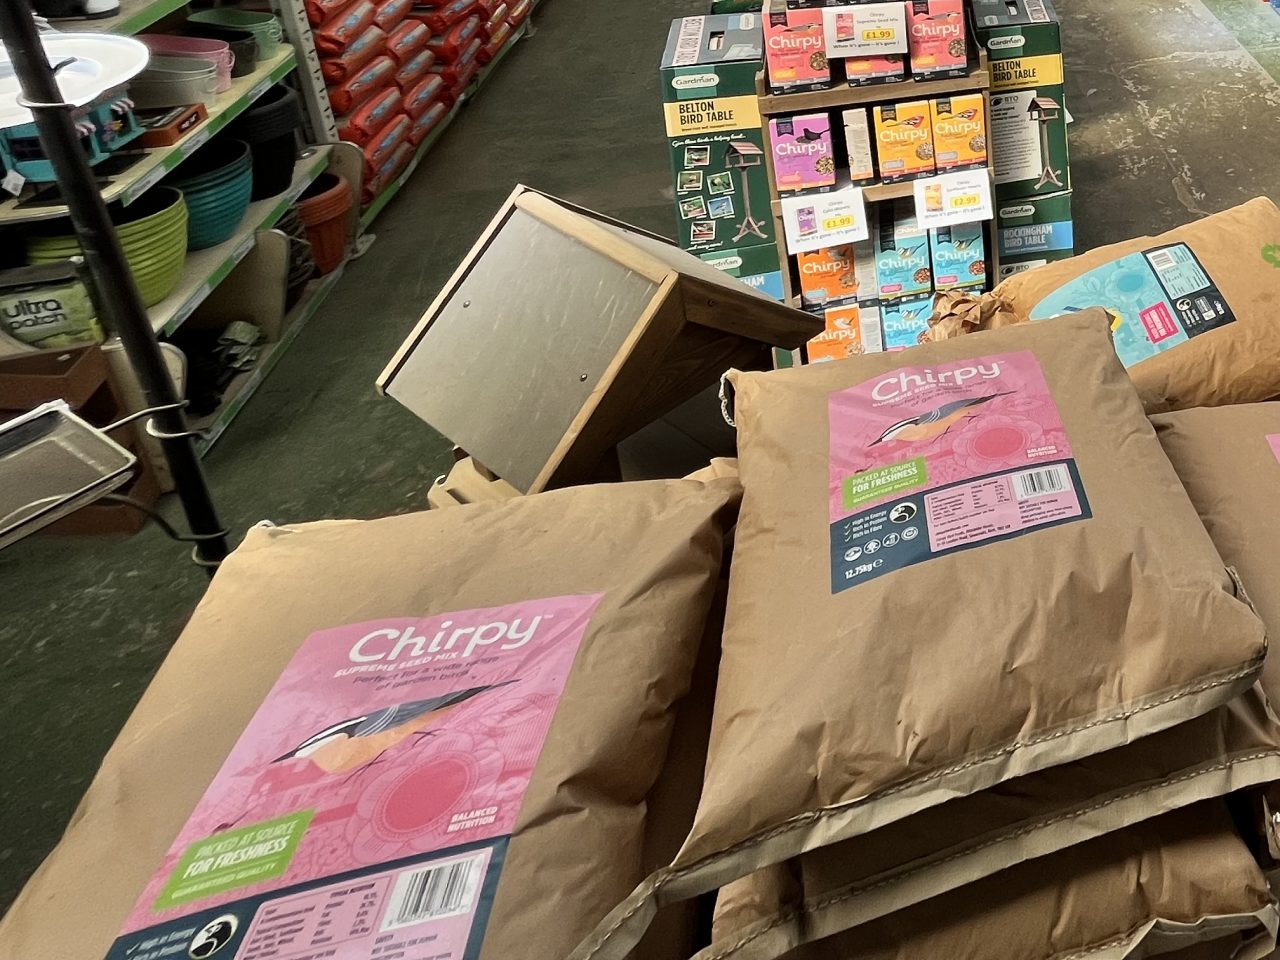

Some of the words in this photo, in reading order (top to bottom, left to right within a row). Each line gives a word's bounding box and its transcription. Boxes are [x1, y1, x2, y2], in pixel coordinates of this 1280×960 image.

[866, 31, 891, 39] £1.99
[911, 21, 961, 39] Chirpy
[768, 33, 822, 53] Chirpy
[990, 37, 1021, 46] Gardman
[992, 60, 1021, 72] BELTON
[675, 76, 715, 86] Gardman
[993, 72, 1012, 82] BIRD
[1014, 68, 1036, 79] TABLE
[679, 101, 714, 114] BELTON
[680, 114, 703, 125] BIRD
[706, 110, 734, 122] TABLE
[934, 120, 981, 134] Chirpy
[879, 128, 929, 143] Chirpy
[775, 140, 828, 157] Chirpy
[954, 197, 977, 206] £2.99
[1001, 206, 1032, 217] Gardman
[826, 217, 851, 228] £1.99
[1003, 225, 1053, 239] ROCKINGHAM
[1004, 237, 1021, 248] BIRD
[1023, 234, 1046, 245] TABLE
[879, 255, 926, 271] Chirpy
[934, 248, 981, 263] Chirpy
[801, 259, 850, 274] Chirpy
[2, 297, 63, 319] ultra
[871, 361, 1000, 401] Chirpy
[872, 391, 912, 407] SUPREME
[852, 471, 879, 486] PACKED
[880, 469, 888, 477] AT
[890, 461, 916, 474] SOURCE
[852, 482, 870, 495] FOR
[871, 466, 918, 488] FRESHNESS
[870, 510, 887, 520] Energy
[845, 562, 873, 579] 12.75kg
[349, 614, 541, 662] Chirpy
[334, 664, 396, 678] SUPREME
[399, 656, 432, 669] SEED
[434, 651, 459, 662] MIX
[352, 672, 398, 684] Perfect
[450, 806, 498, 823] BALANCED
[447, 814, 496, 834] NUTRITION
[194, 836, 239, 859] PACKED
[237, 831, 256, 847] AT
[255, 820, 299, 841] SOURCE
[183, 858, 214, 879] FOR
[211, 835, 291, 871] FRESHNESS
